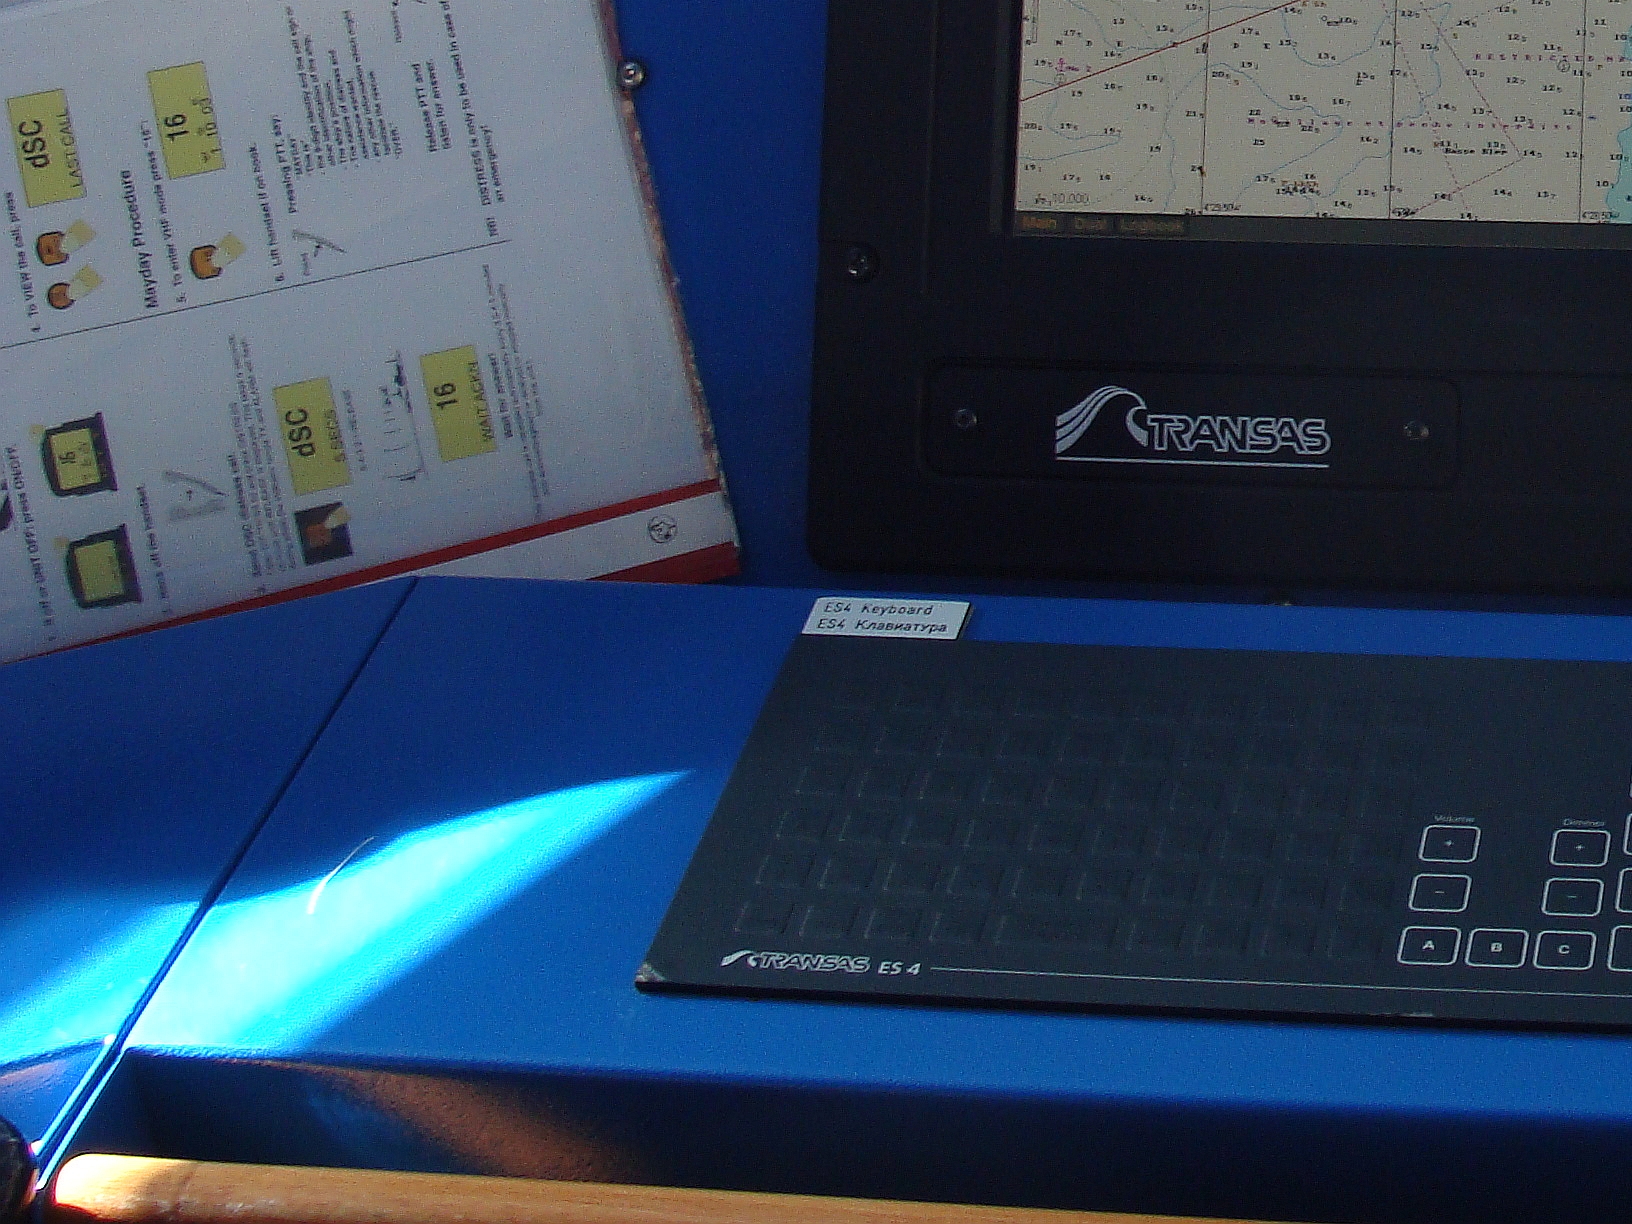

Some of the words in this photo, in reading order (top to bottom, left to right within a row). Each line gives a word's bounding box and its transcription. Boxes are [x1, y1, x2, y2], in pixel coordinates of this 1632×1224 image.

[164, 114, 188, 141] 16
[18, 120, 49, 167] dSC
[65, 152, 82, 186] LAST
[121, 170, 144, 246] Procedure
[138, 252, 157, 307] Mayday
[433, 383, 457, 409] 16
[285, 409, 315, 456] dSC
[1147, 414, 1332, 455] TRANSAS
[824, 602, 851, 613] ES4
[861, 602, 933, 616] Keyboard
[817, 618, 846, 629] ES4
[855, 619, 948, 633] Клавиатура
[1422, 939, 1435, 951] A
[1490, 942, 1503, 953] B
[1558, 944, 1570, 954] C
[758, 951, 871, 973] TRANSAS
[878, 962, 902, 975] ES
[906, 963, 922, 976] 4
